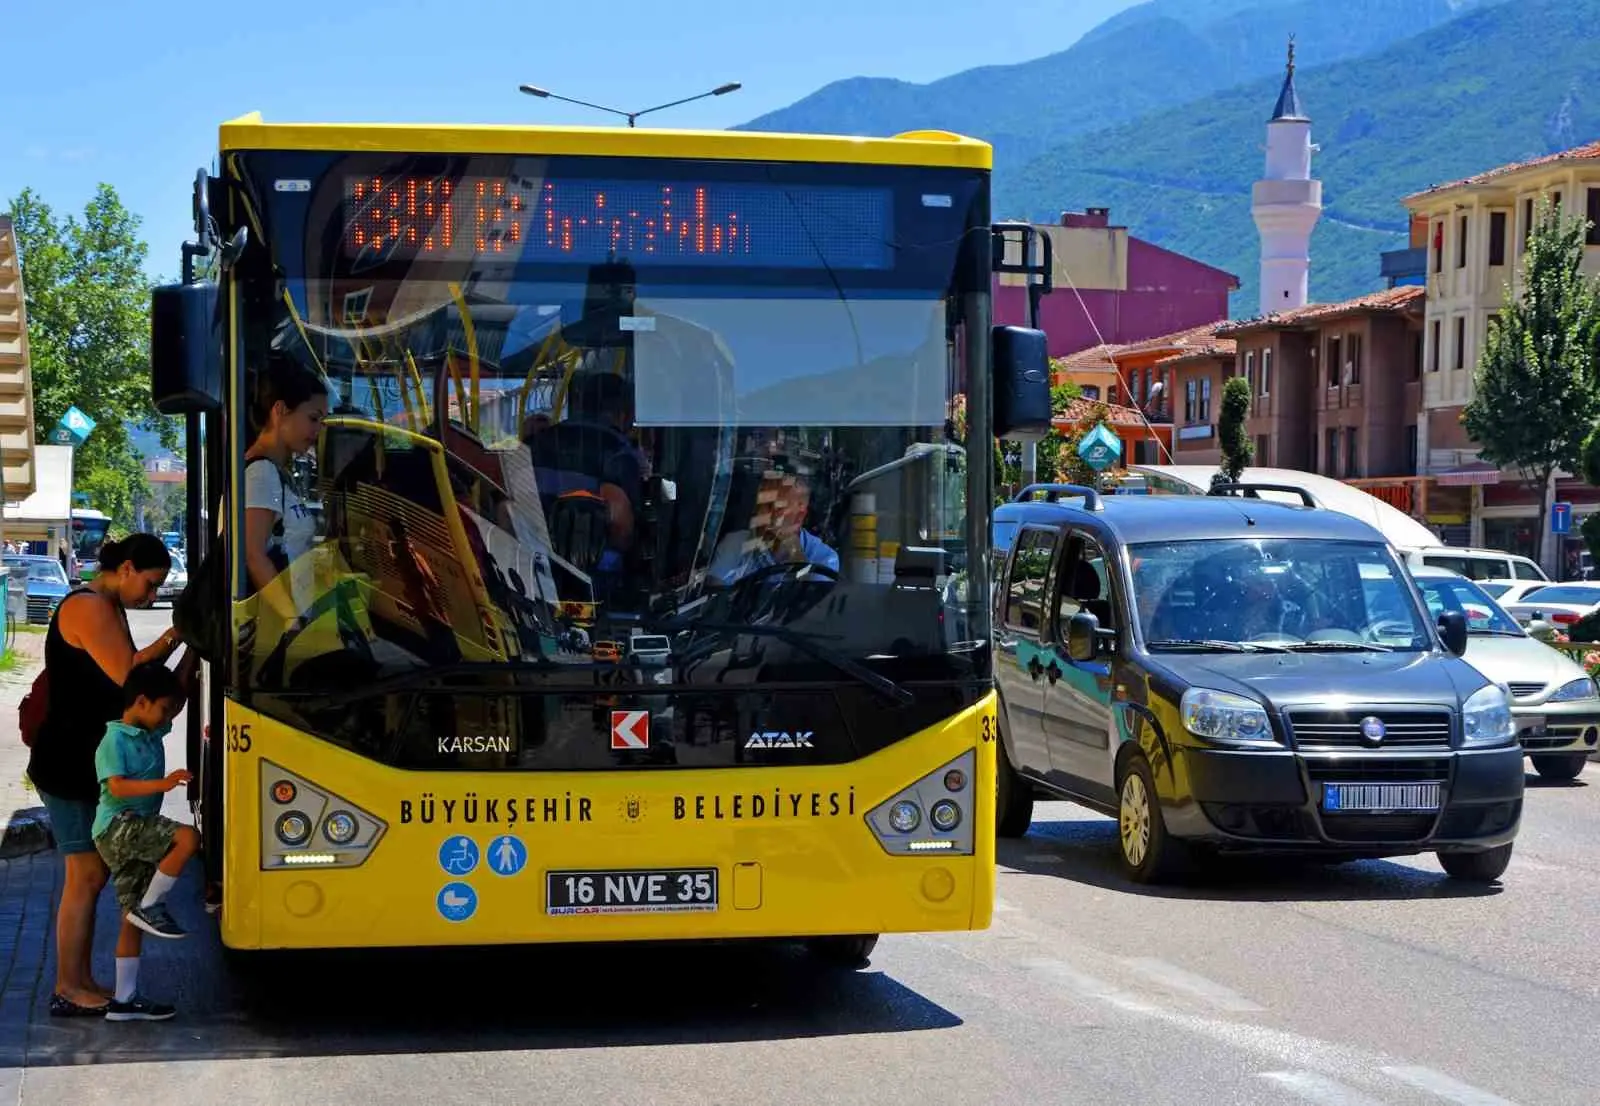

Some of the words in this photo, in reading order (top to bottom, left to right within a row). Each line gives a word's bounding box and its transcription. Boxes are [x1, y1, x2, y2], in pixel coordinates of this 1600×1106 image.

[438, 736, 510, 753] KARSAN
[744, 731, 815, 748] ATAK
[400, 791, 592, 828] BÜYÜKŞEHİR
[673, 785, 856, 820] BELEDİYESİ
[565, 876, 595, 904] 16
[605, 875, 667, 902] NVE
[676, 873, 712, 901] 35
